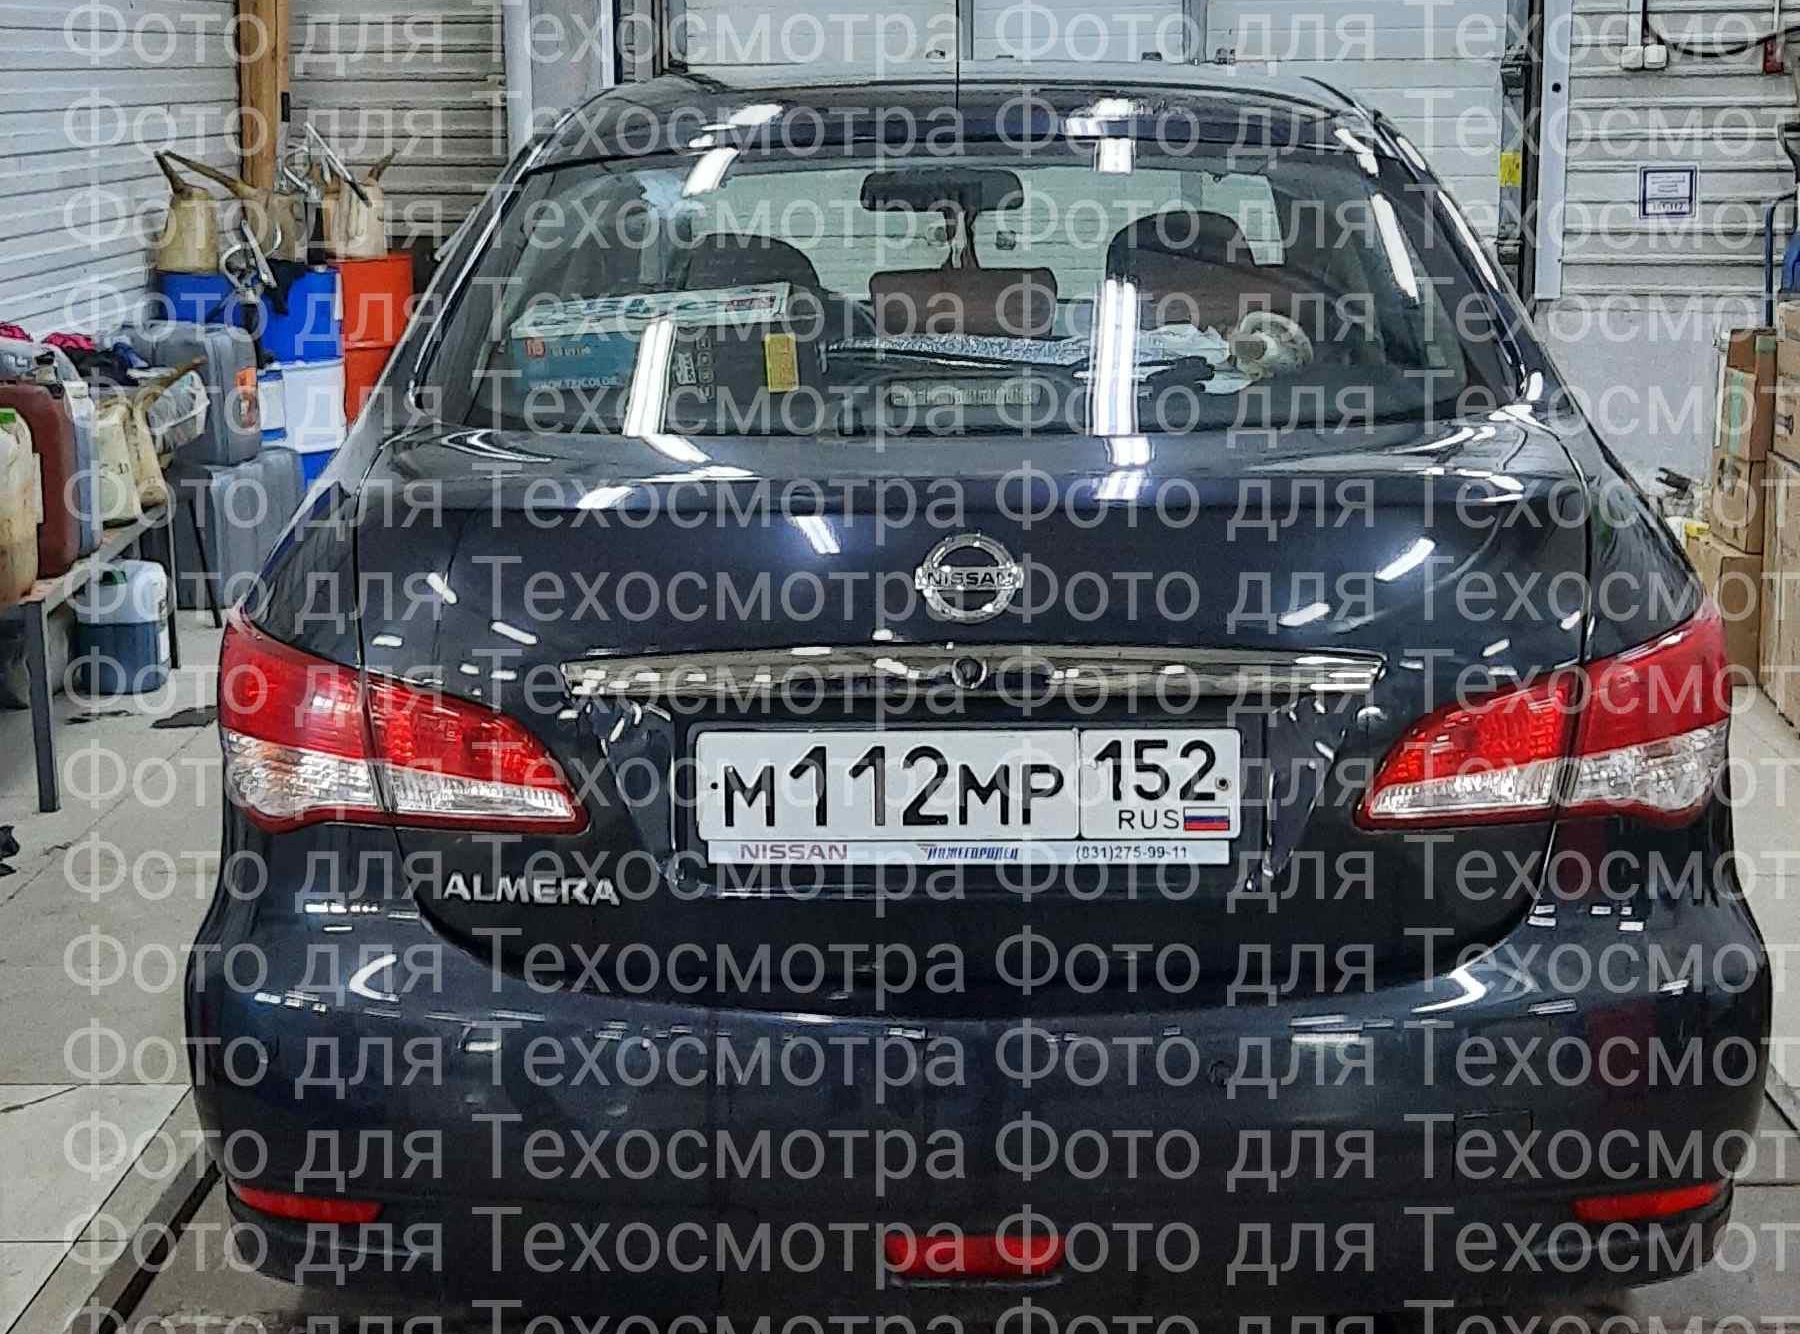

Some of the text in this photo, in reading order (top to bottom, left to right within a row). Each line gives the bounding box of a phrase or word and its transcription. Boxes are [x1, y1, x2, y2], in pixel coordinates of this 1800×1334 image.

[927, 571, 1015, 586] NISSAN
[1095, 738, 1217, 802] 152
[1118, 808, 1179, 830] RUS
[740, 843, 849, 861] NISSAN
[1075, 845, 1189, 861] (831)275-99-11
[443, 872, 621, 907] ALMERA
